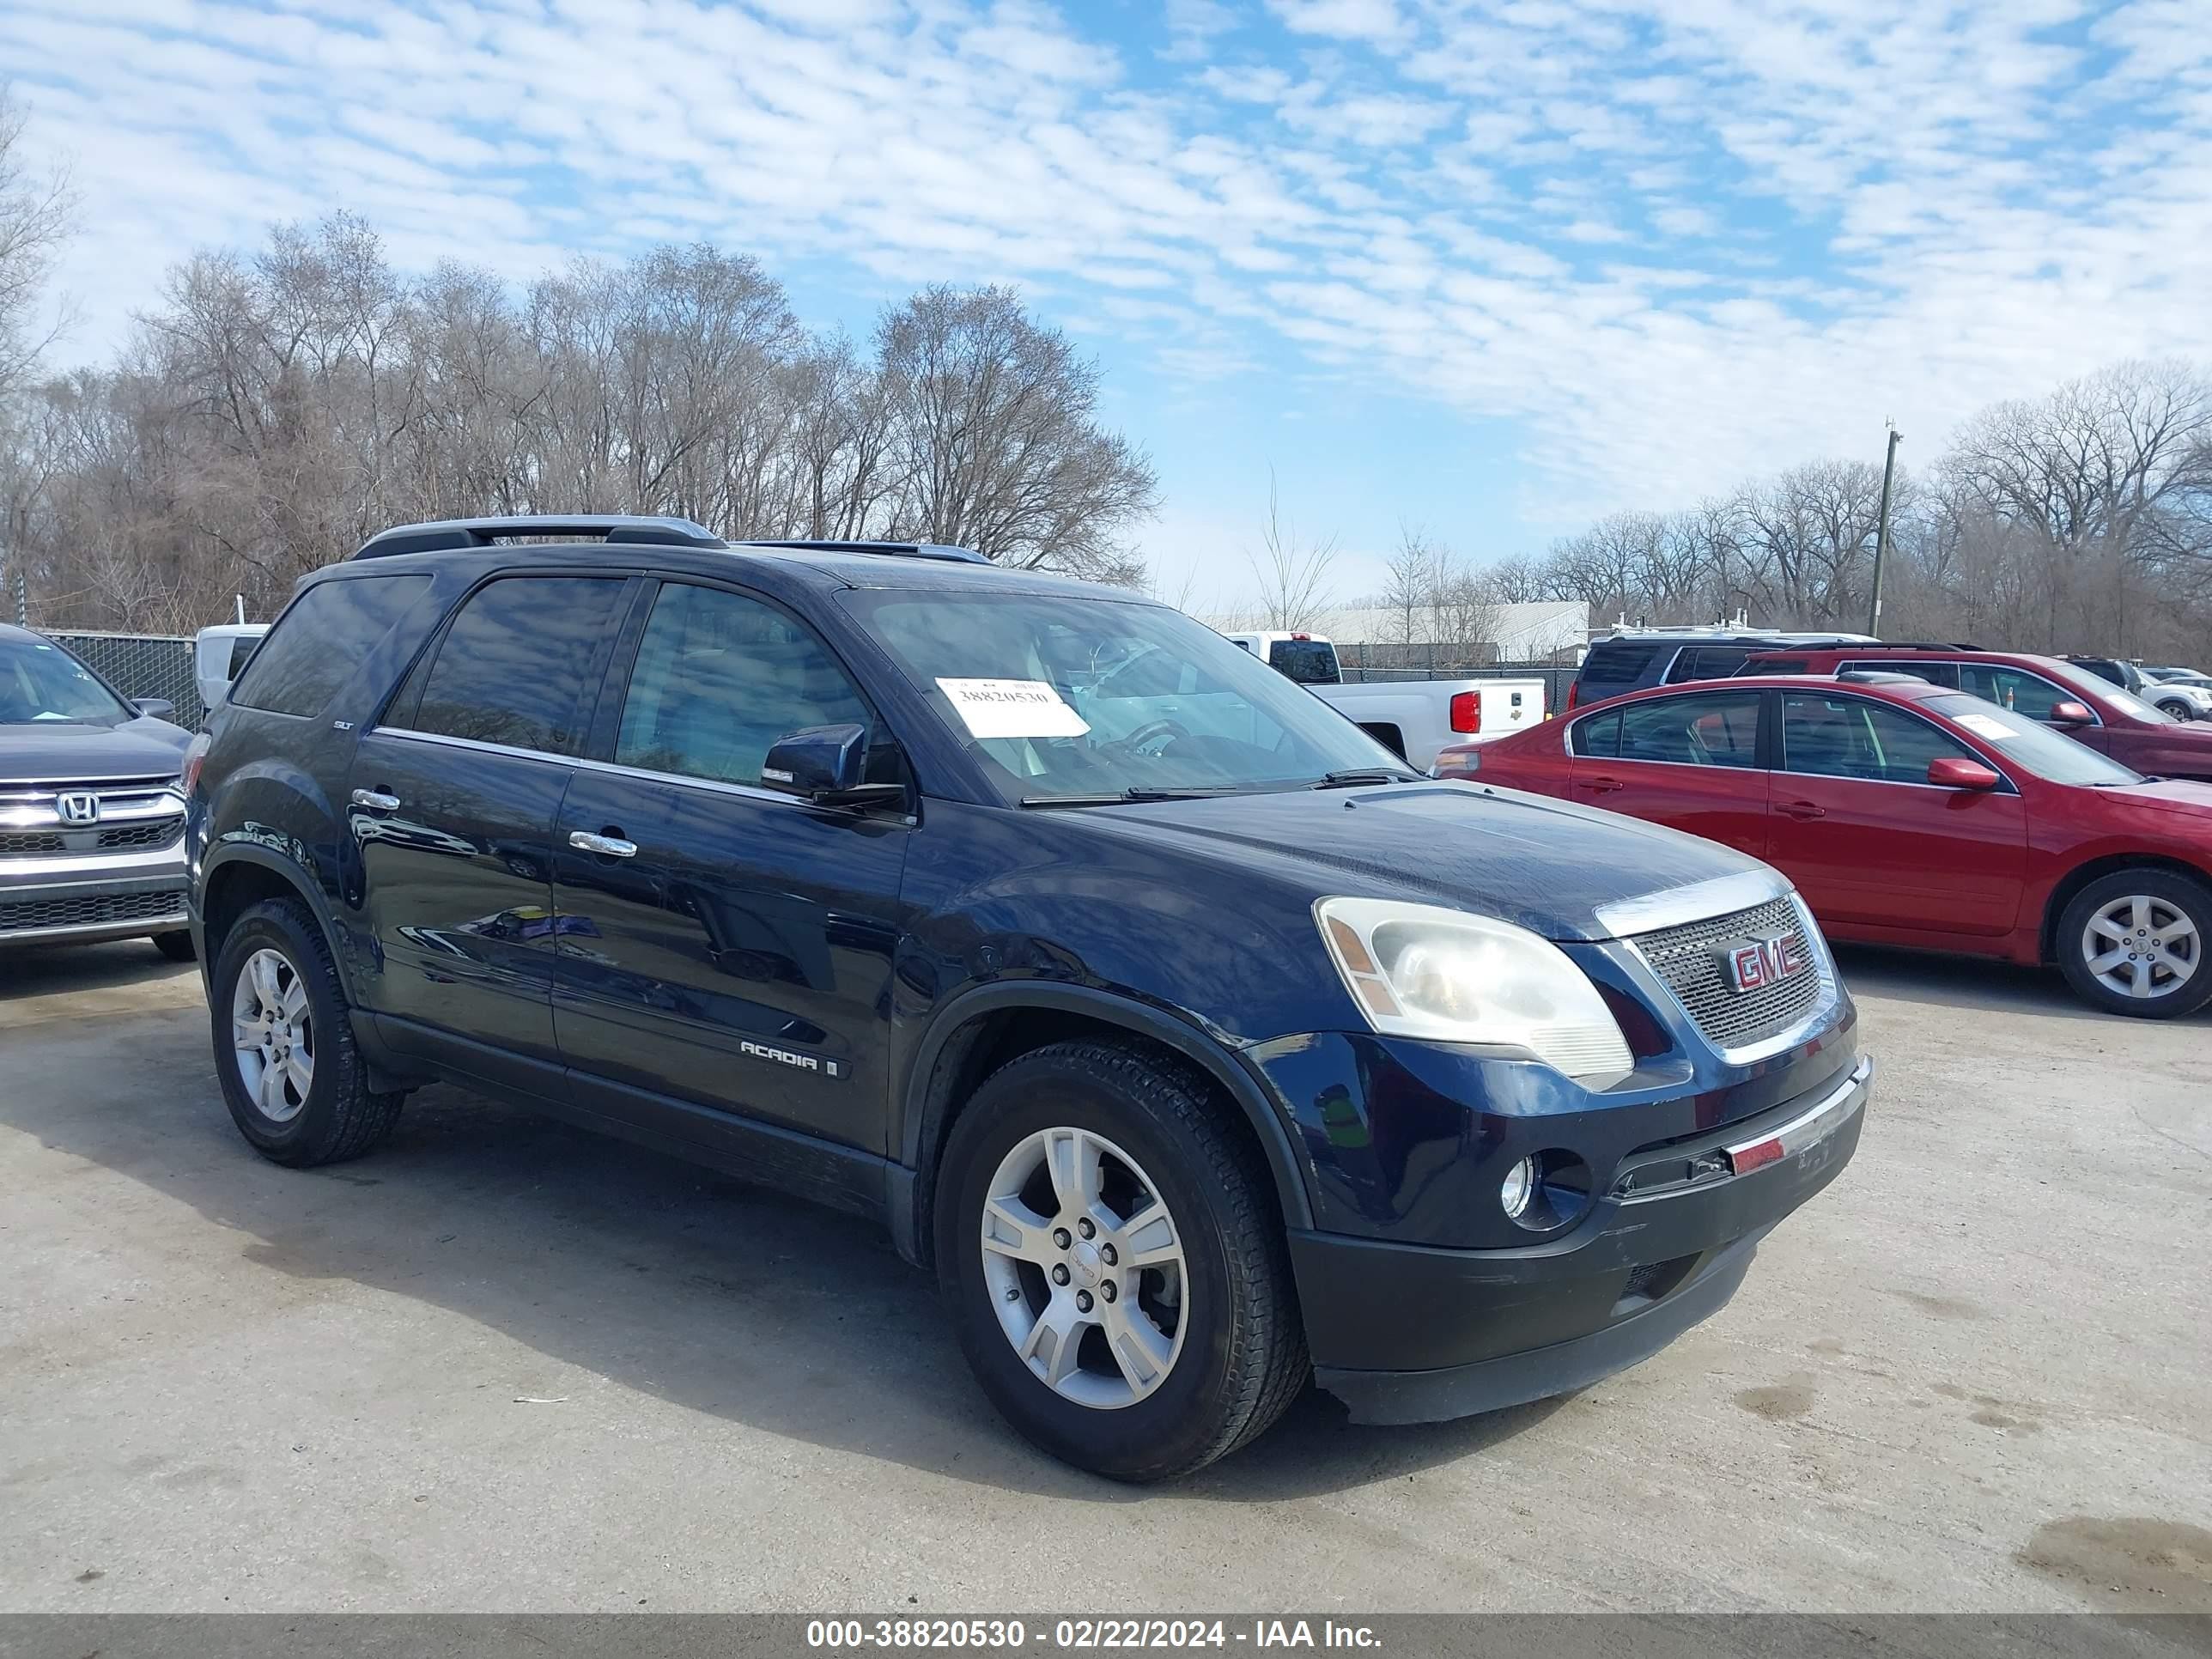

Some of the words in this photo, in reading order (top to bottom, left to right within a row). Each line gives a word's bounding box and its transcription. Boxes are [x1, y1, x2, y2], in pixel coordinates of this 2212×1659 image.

[959, 690, 1048, 703] 38820530
[333, 720, 355, 730] SLT
[1729, 930, 1802, 992] GMC
[740, 1041, 818, 1071] ACADIA
